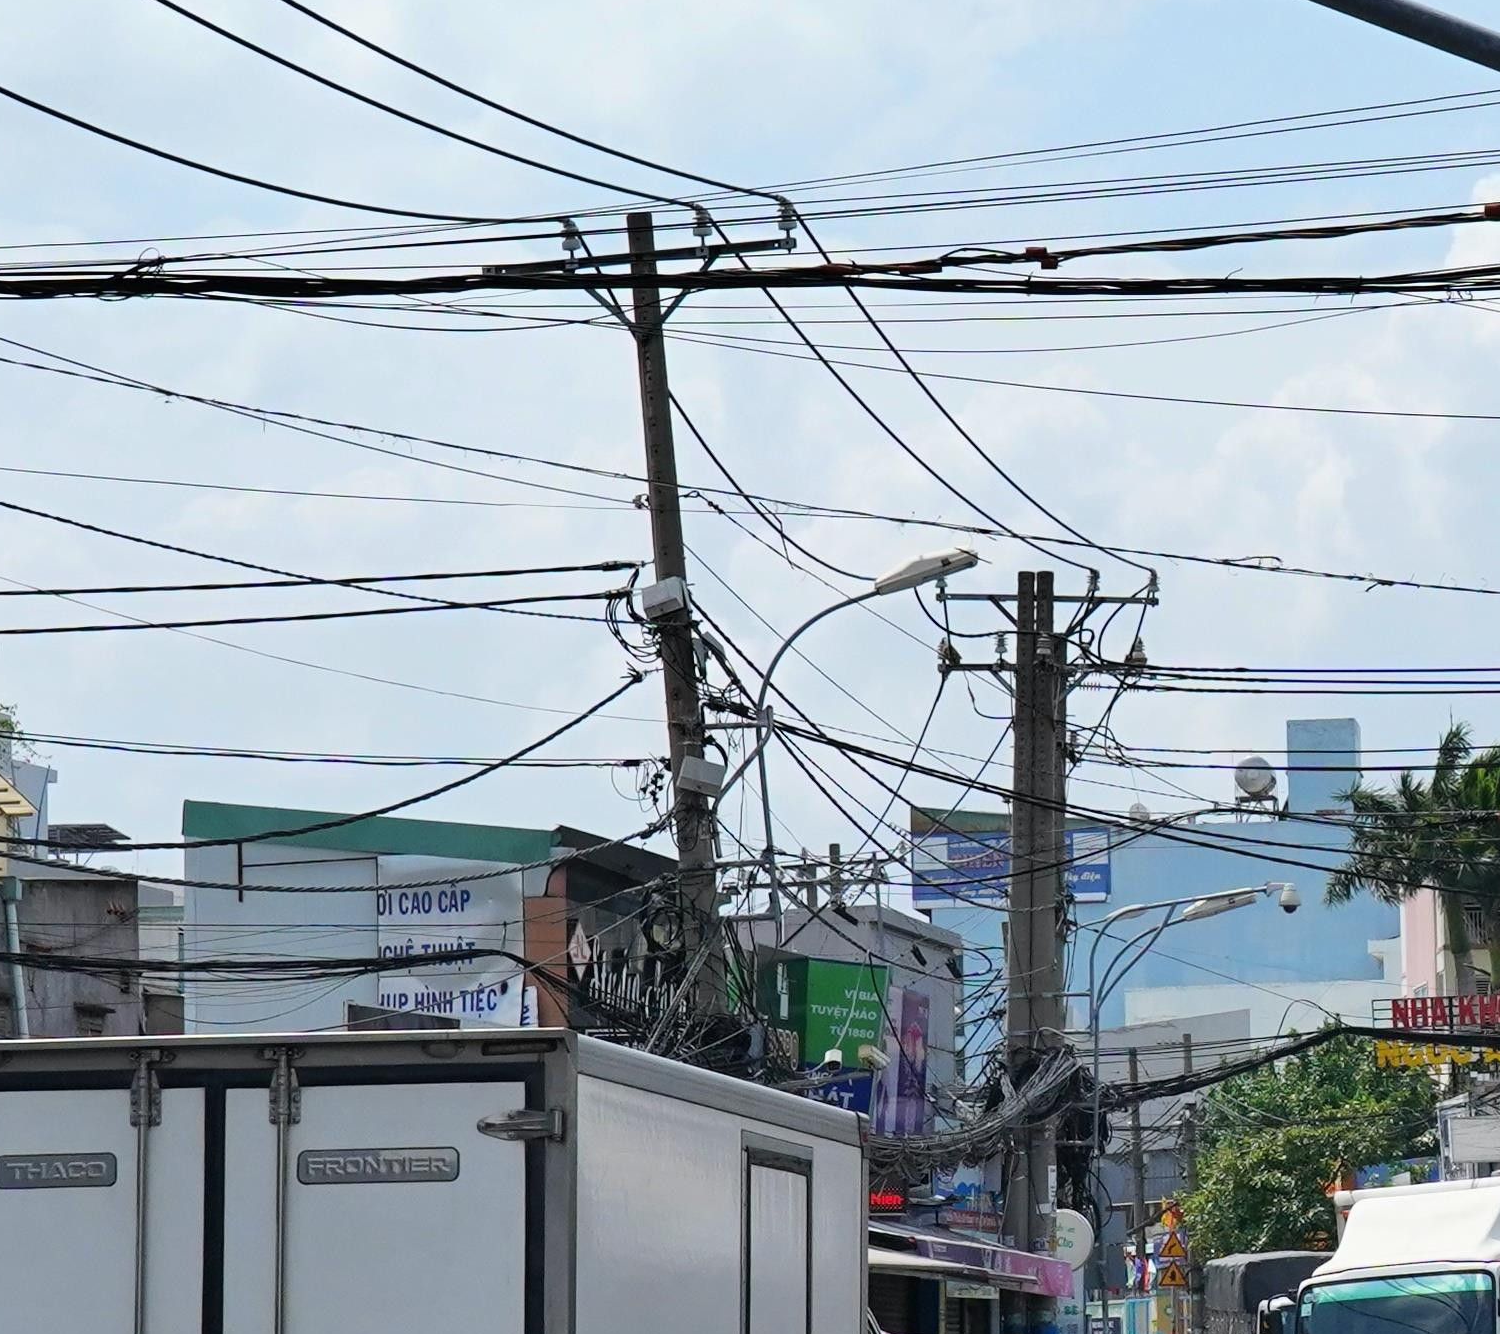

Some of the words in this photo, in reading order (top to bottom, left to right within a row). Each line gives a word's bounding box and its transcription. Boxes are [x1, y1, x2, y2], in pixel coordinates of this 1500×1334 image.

[399, 893, 434, 916] CAO
[415, 986, 453, 1014] HÌNH
[459, 982, 498, 1014] TIỆC
[1390, 995, 1450, 1029] NHA
[5, 1160, 108, 1180] THACO
[306, 1155, 452, 1176] FRONTIER
